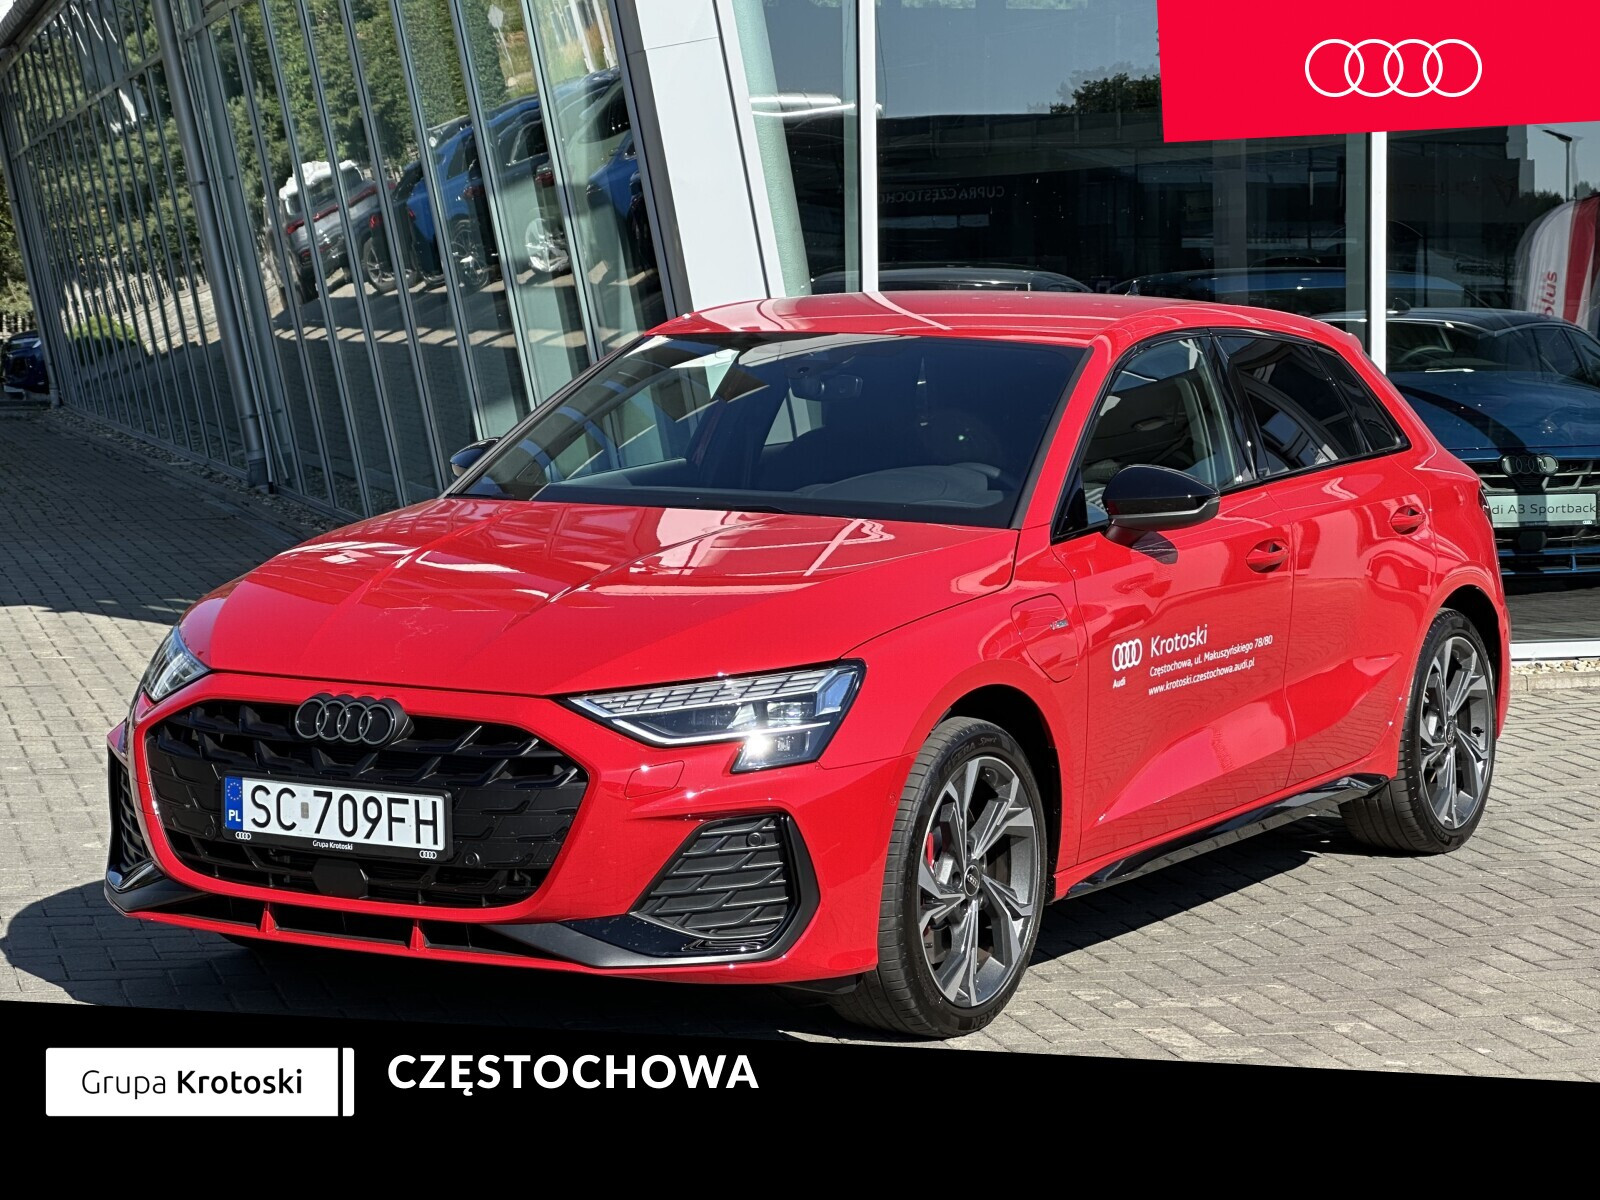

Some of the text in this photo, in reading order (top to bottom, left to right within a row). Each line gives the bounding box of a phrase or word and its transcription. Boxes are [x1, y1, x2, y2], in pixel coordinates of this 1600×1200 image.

[1508, 504, 1525, 514] A3
[1531, 503, 1597, 515] Sportback
[1150, 624, 1208, 658] Krotoski
[1150, 635, 1273, 677] Częstochowa, ul. Makuszyńskiego 78/80
[1113, 677, 1126, 688] Audi
[1148, 656, 1256, 696] www.krotoski.czestochowa.audi.pl
[229, 810, 241, 822] PL
[250, 784, 439, 847] SC 709FH
[312, 840, 354, 851] Grupa Krotoski
